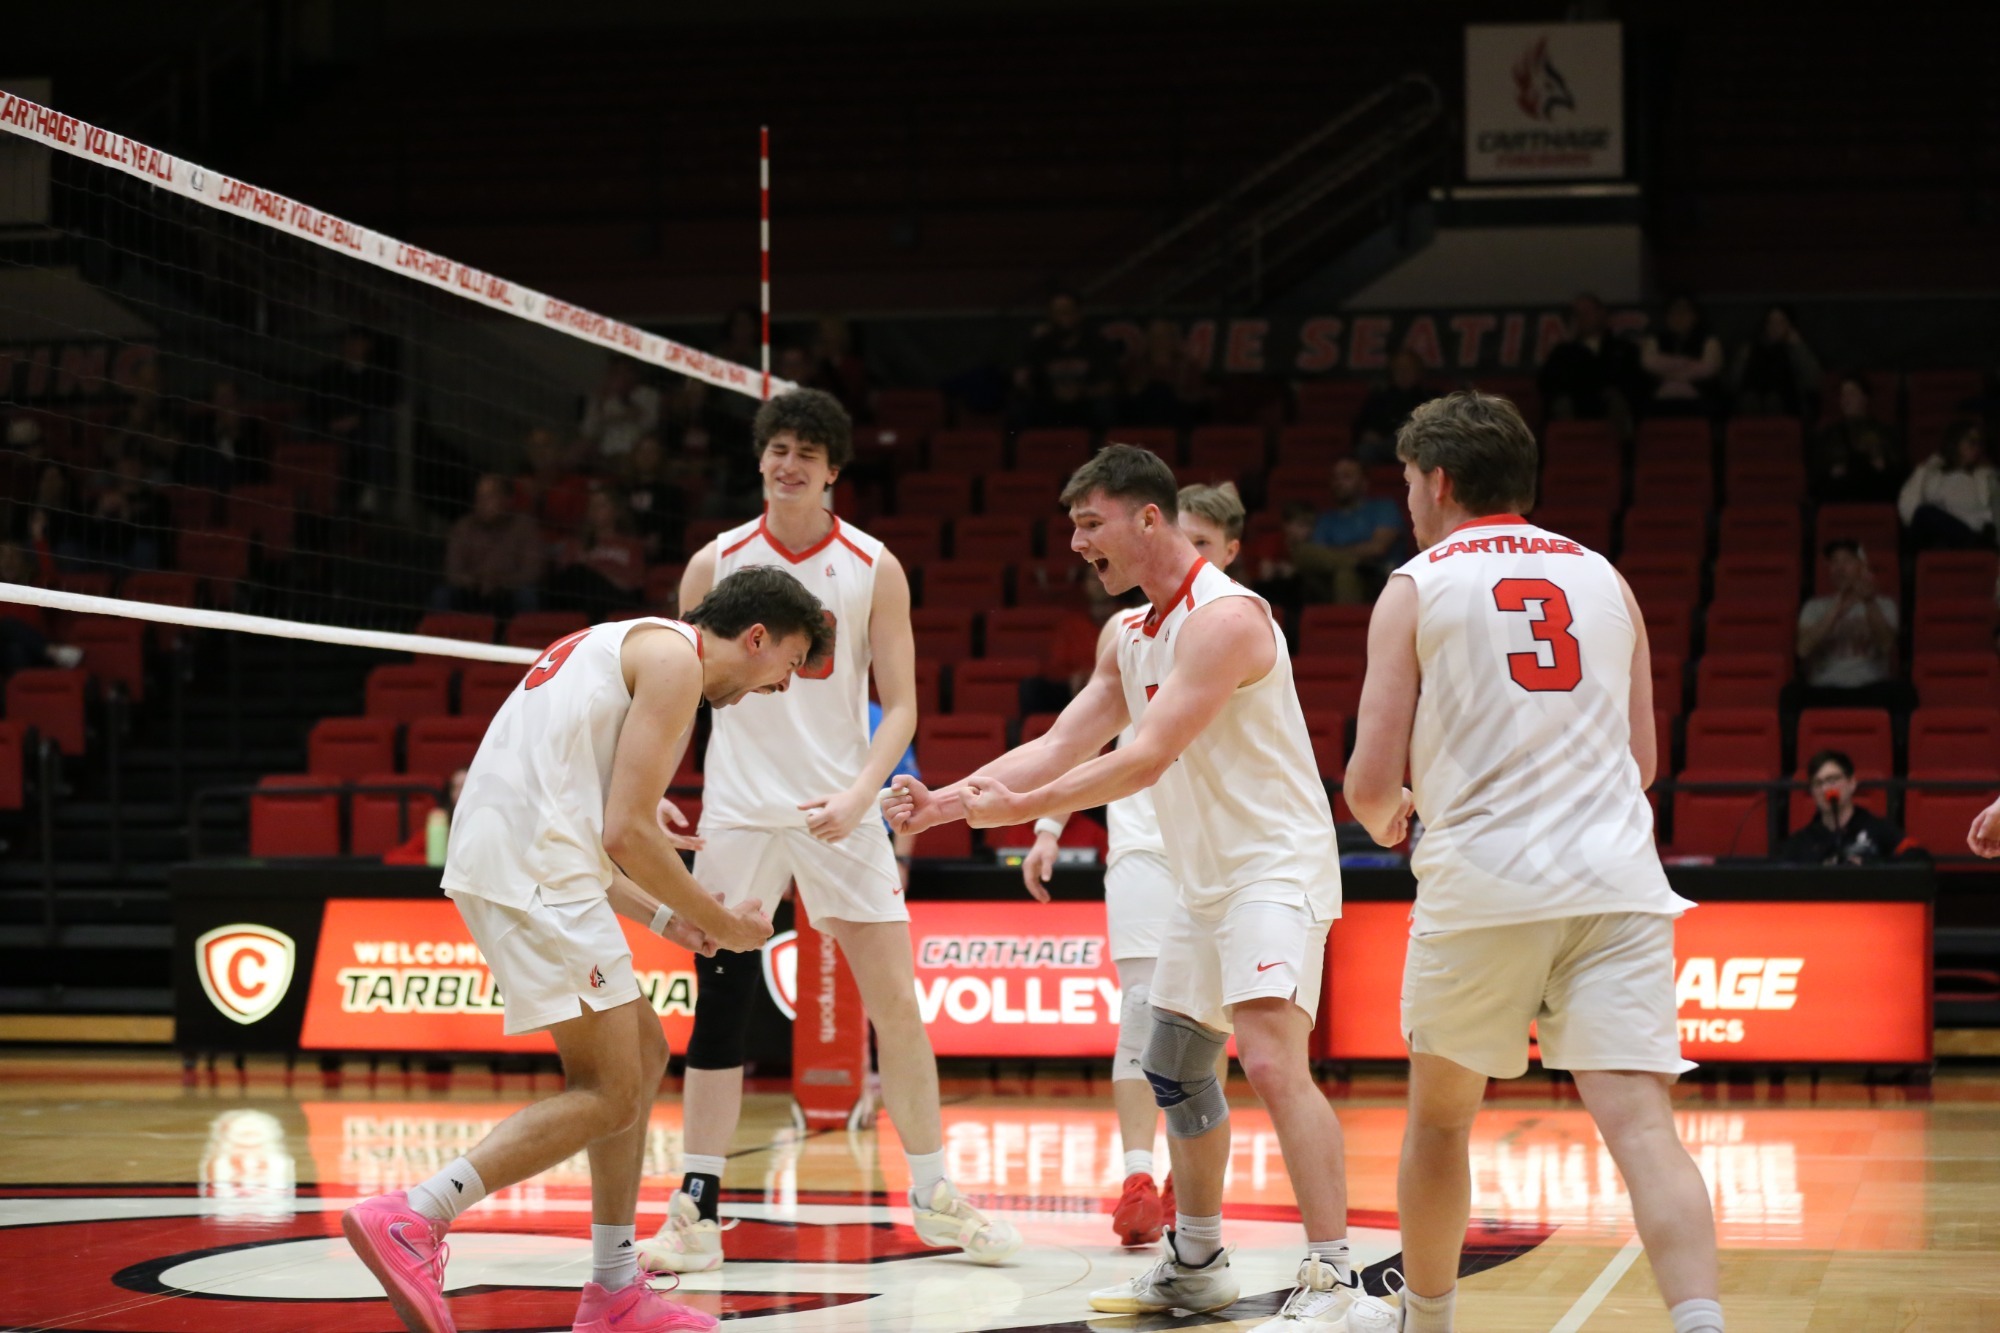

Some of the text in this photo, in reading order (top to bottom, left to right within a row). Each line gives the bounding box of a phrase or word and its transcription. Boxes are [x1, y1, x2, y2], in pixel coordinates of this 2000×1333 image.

[0, 91, 80, 146] ARTHAGE
[1428, 535, 1585, 564] CARTHAGE
[1492, 577, 1583, 692] 3
[921, 938, 1102, 967] CARTHAGE
[914, 976, 1122, 1024] VOLLEY
[1674, 957, 1804, 1011] AGE
[1676, 1018, 1745, 1043] TICS
